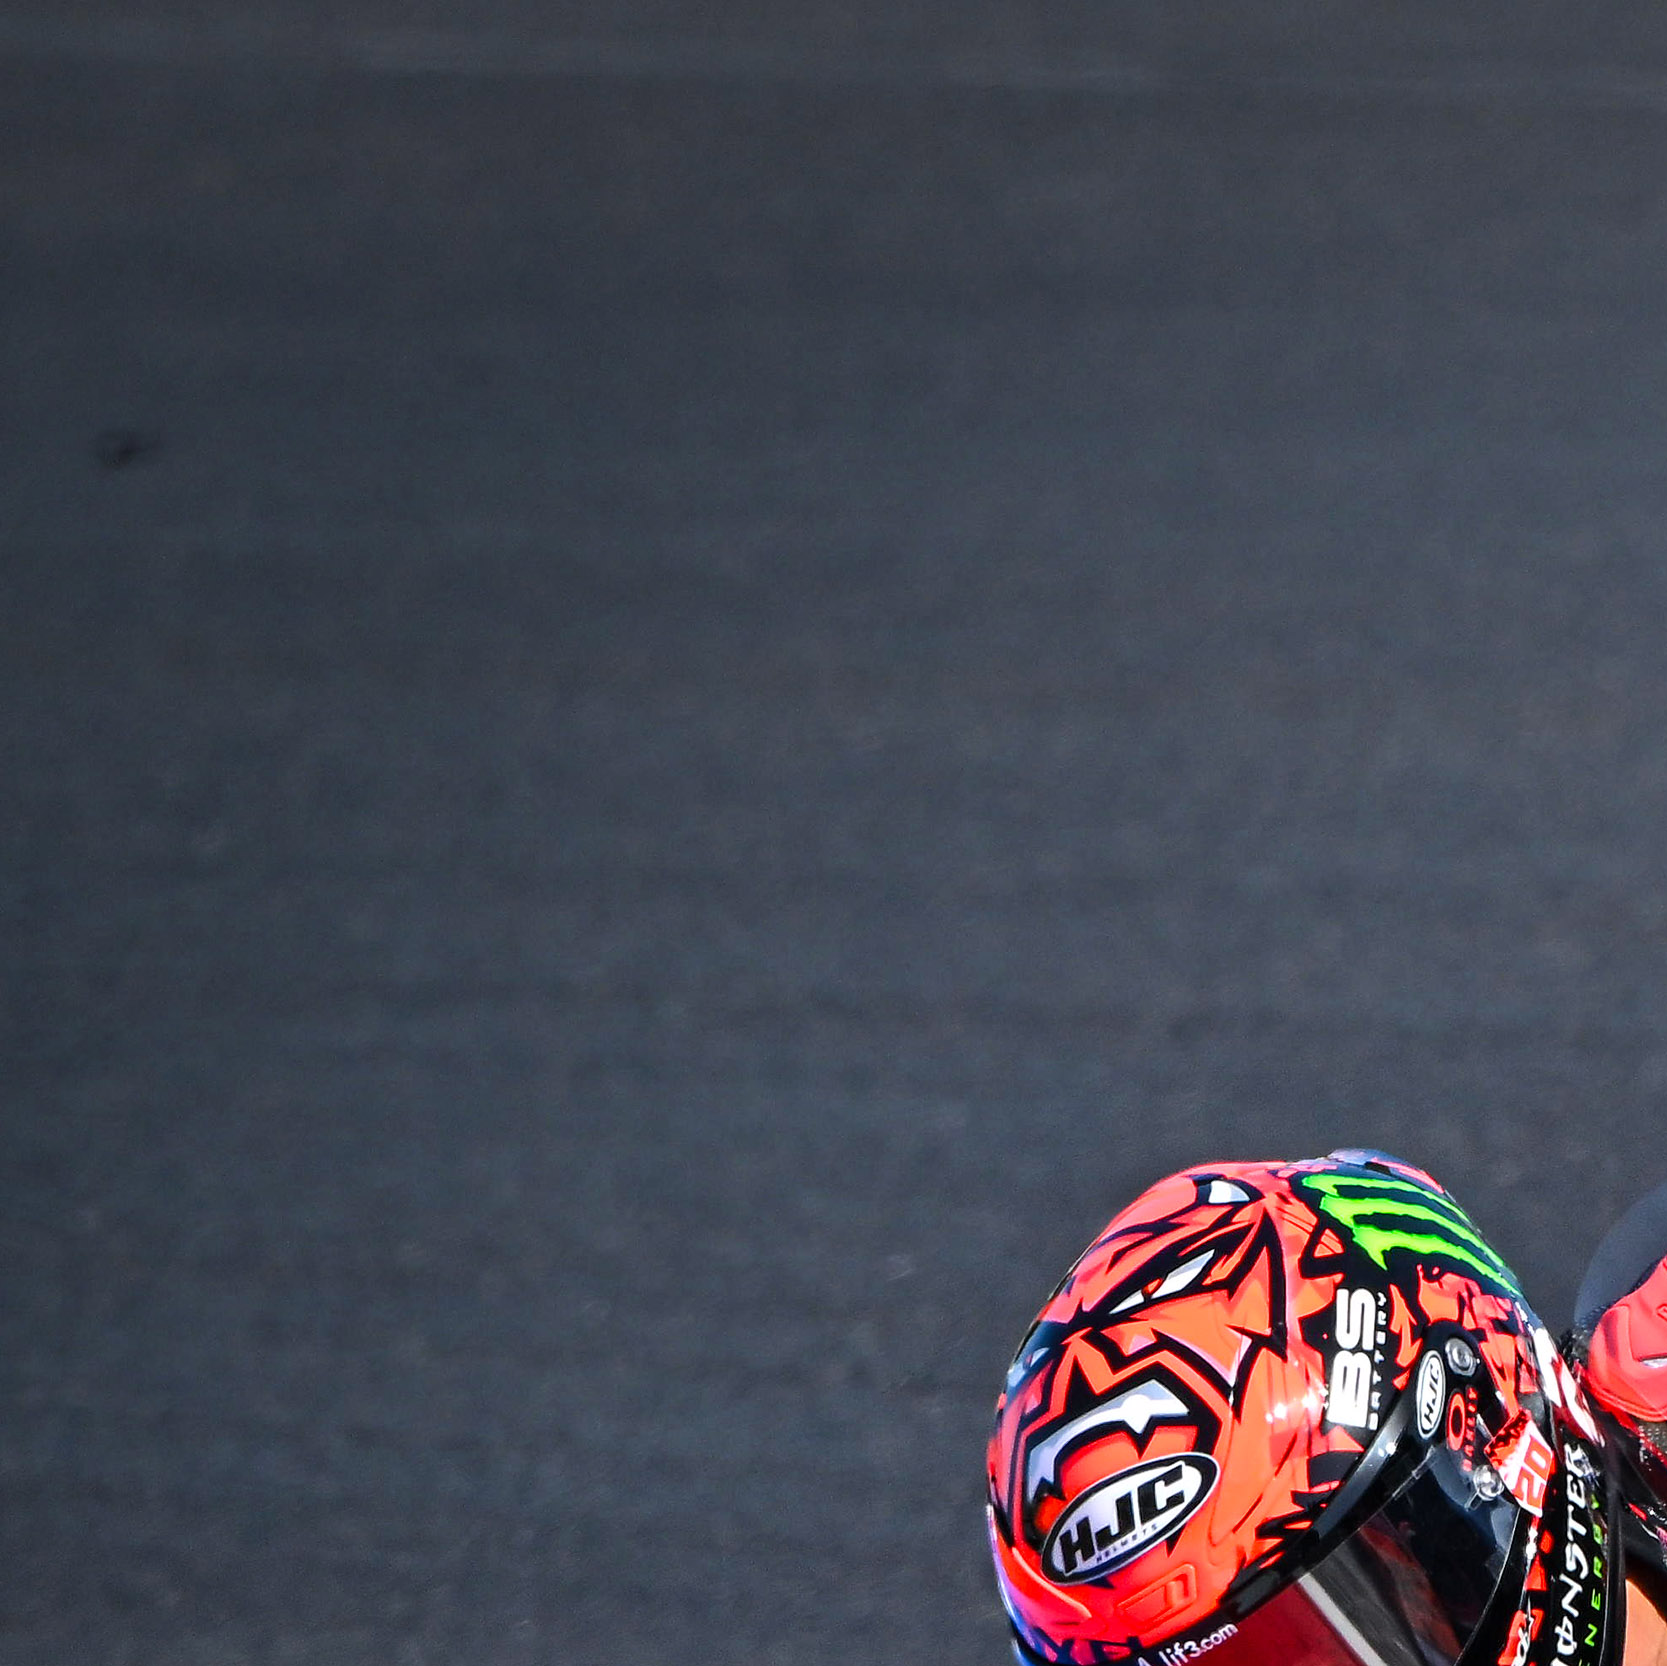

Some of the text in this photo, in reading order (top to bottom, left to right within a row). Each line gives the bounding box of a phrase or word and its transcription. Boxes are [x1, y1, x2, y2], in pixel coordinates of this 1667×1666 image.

[1326, 1288, 1377, 1429] BS
[1368, 1291, 1387, 1431] BATTERY
[1422, 1362, 1441, 1431] HJC
[1460, 1386, 1479, 1471] OAKLEY
[1513, 1434, 1553, 1510] 20
[1058, 1463, 1186, 1576] HJC
